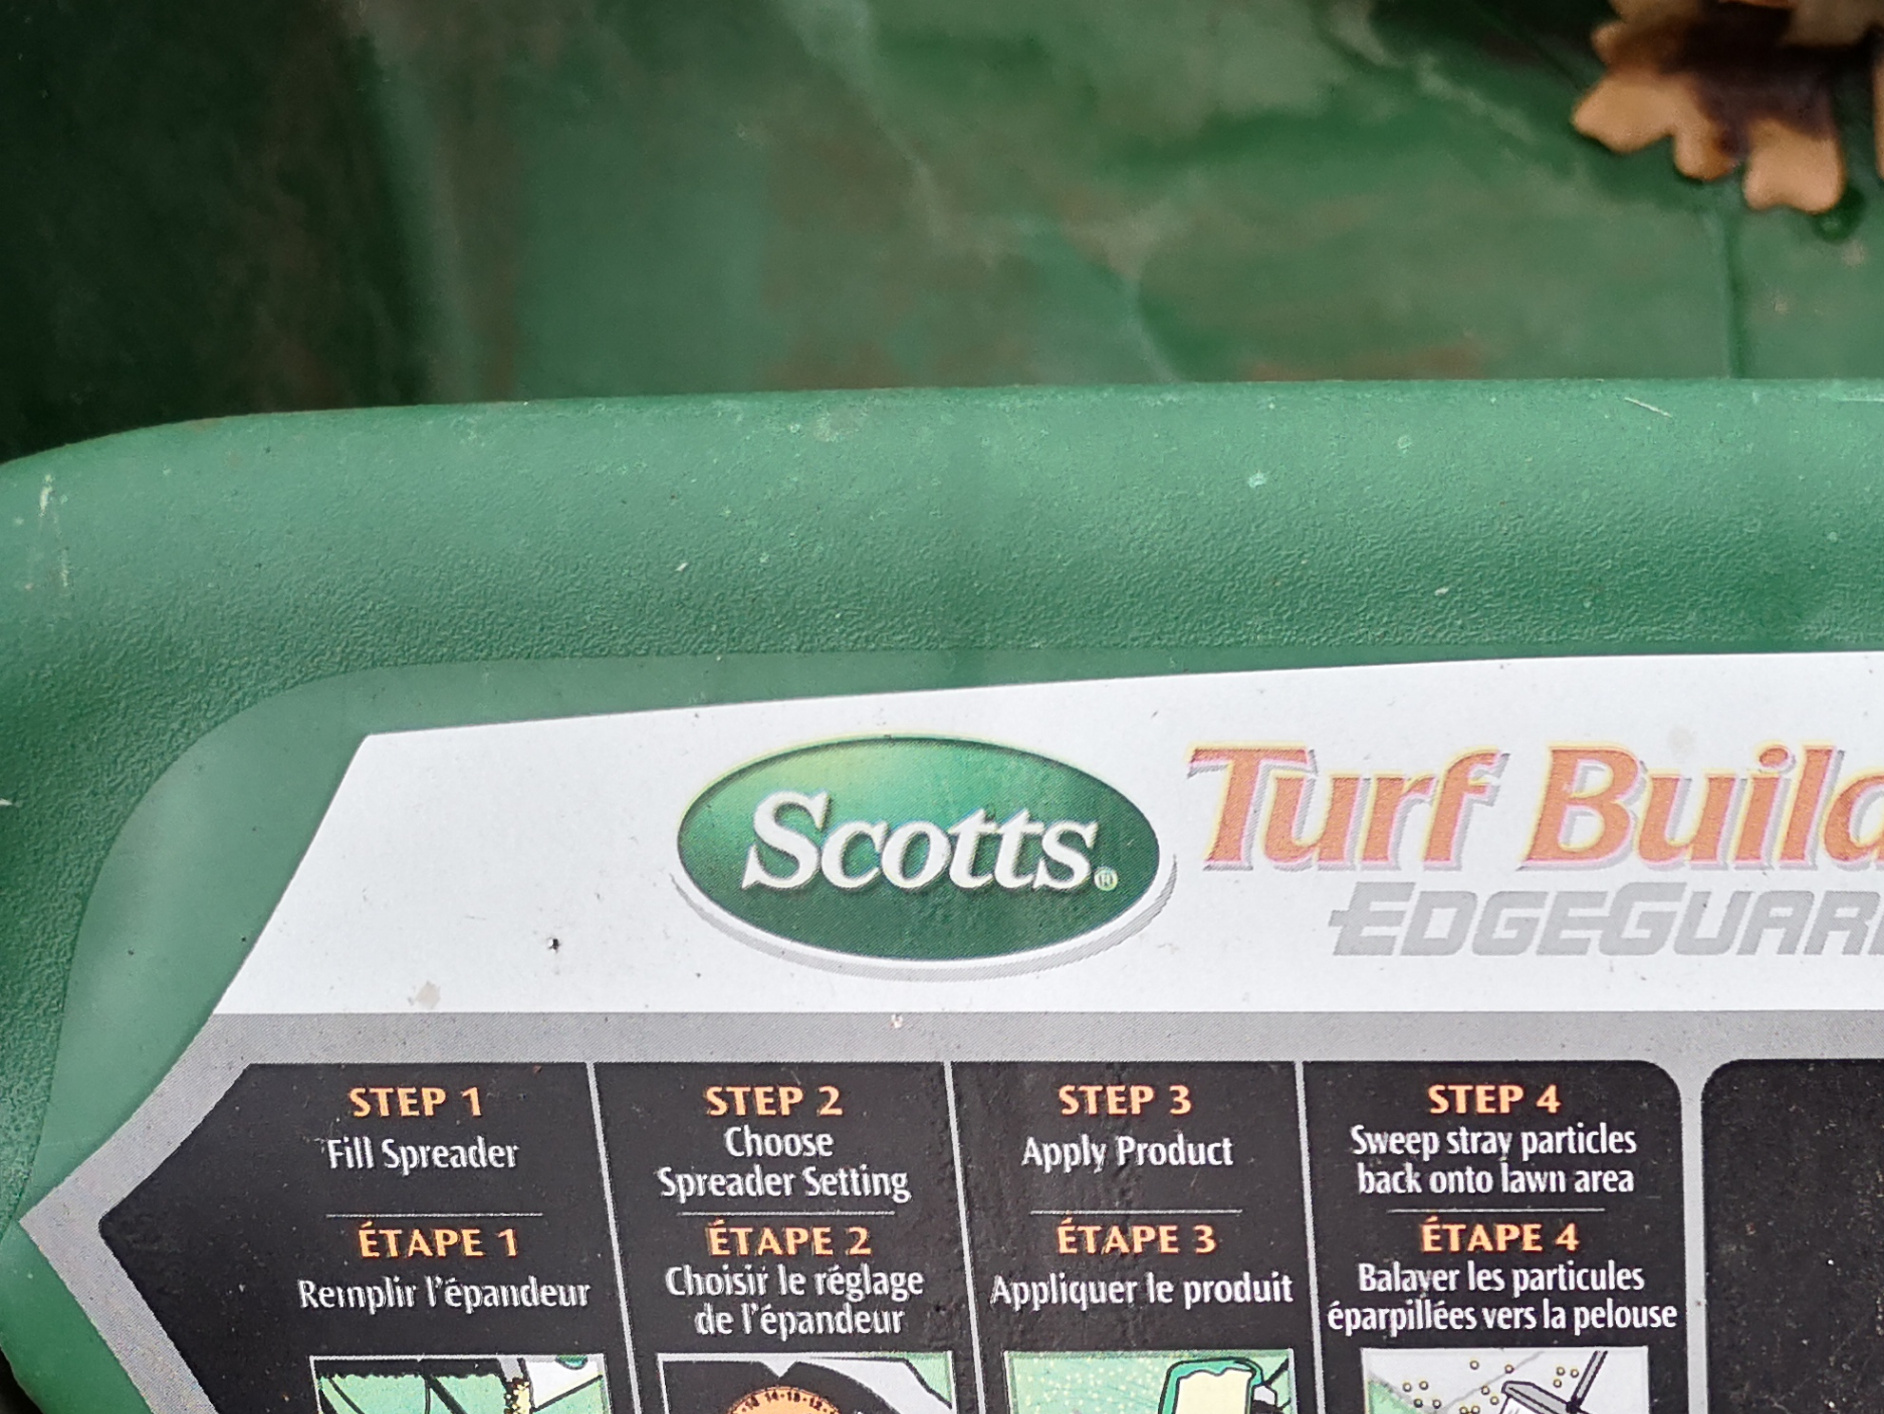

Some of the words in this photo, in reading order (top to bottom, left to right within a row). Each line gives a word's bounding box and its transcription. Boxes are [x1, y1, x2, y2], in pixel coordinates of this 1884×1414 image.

[1187, 741, 1511, 873] Turf
[350, 1087, 446, 1116] STEP
[462, 1088, 483, 1115] 1
[706, 1087, 803, 1116] STEP
[819, 1087, 843, 1115] 2
[1059, 1085, 1155, 1115] STEP
[1171, 1085, 1192, 1115] 3
[1428, 1084, 1524, 1115] STEP
[1536, 1084, 1561, 1114] 4
[327, 1138, 374, 1170] Fill
[383, 1138, 519, 1176] Spreader
[724, 1125, 834, 1157] Choose
[1022, 1137, 1105, 1173] Apply
[1117, 1137, 1233, 1167] Product
[1351, 1125, 1439, 1159] Sweep
[1446, 1125, 1512, 1161] stray
[1521, 1124, 1635, 1158] particles
[659, 1167, 796, 1201] Spreader
[804, 1167, 911, 1202] Setting
[1359, 1164, 1420, 1194] back
[1429, 1167, 1492, 1194] onto
[1501, 1164, 1565, 1194] lawn
[1574, 1170, 1634, 1193] area
[358, 1223, 483, 1257] ÉTAPE
[498, 1230, 518, 1256] 1
[708, 1221, 834, 1256] ÉTAPE
[847, 1228, 871, 1255] 2
[1057, 1217, 1180, 1254] ÉTAPE
[1196, 1223, 1216, 1253] 3
[1421, 1216, 1543, 1252] ÉTAPE
[1555, 1224, 1579, 1251] 4
[298, 1278, 417, 1314] Remplir
[666, 1266, 768, 1296] Choisir
[779, 1266, 806, 1295] le
[815, 1266, 924, 1305] réglage
[990, 1273, 1136, 1310] Appliquer
[1148, 1273, 1174, 1303] le
[1183, 1271, 1293, 1310] produit
[1359, 1261, 1460, 1297] Balayer
[1468, 1260, 1505, 1292] les
[1513, 1260, 1645, 1299] particules
[696, 1305, 734, 1336] de
[1328, 1299, 1477, 1337] éparpillées
[1482, 1306, 1537, 1329] vers
[1543, 1299, 1567, 1329] la
[1574, 1298, 1677, 1336] pelouse
